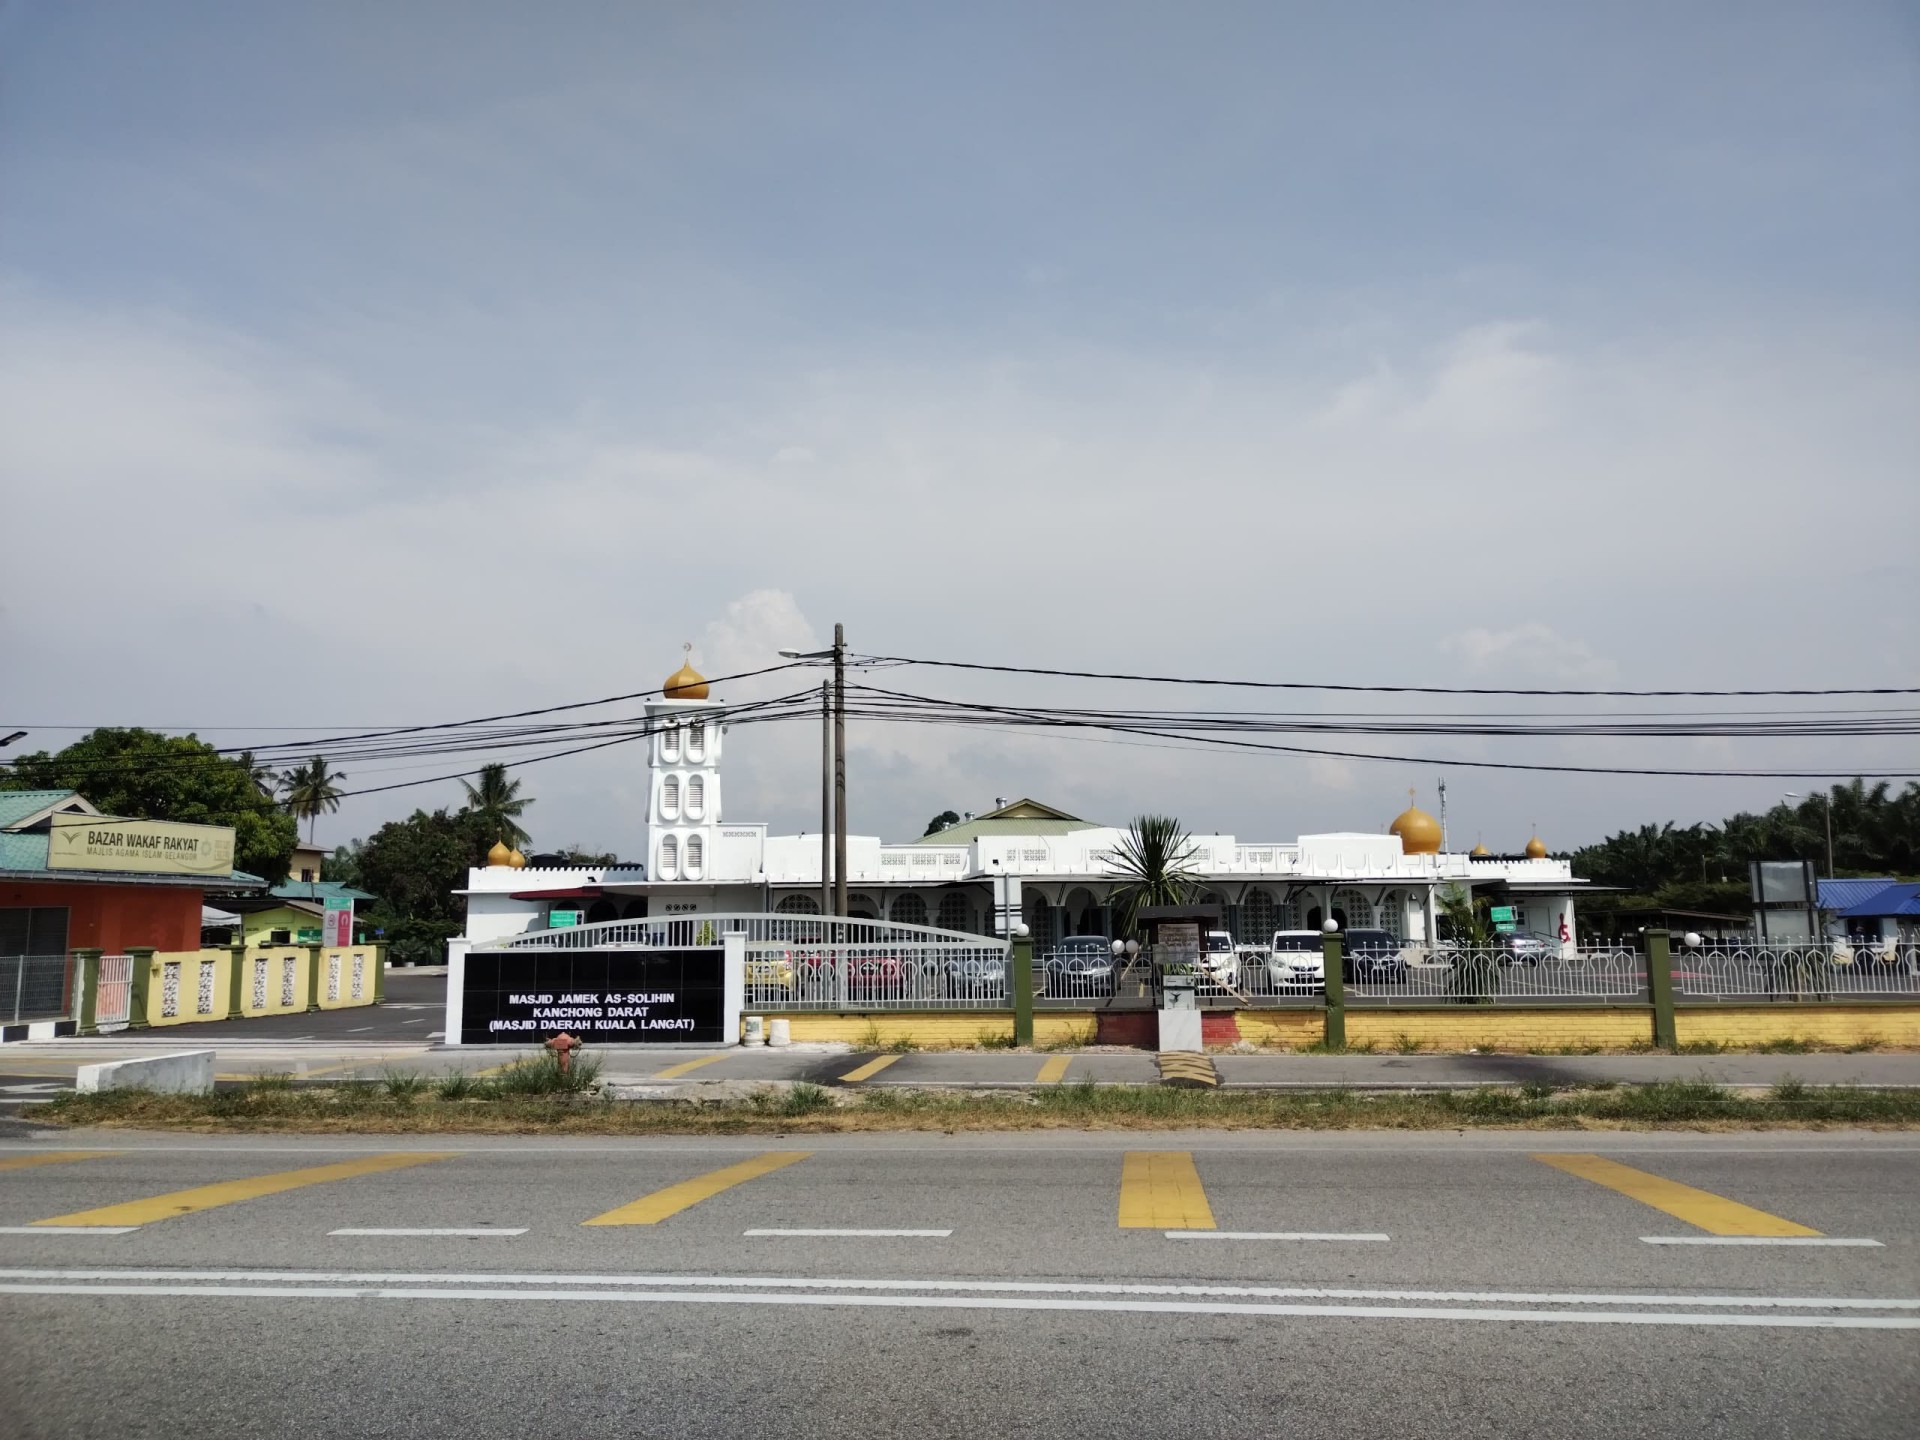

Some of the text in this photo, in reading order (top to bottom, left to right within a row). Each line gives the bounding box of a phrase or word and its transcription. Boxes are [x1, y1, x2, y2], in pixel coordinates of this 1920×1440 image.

[88, 831, 123, 846] BAZAR
[126, 834, 162, 849] WAKAF
[163, 837, 199, 851] RAKYAT
[87, 847, 113, 856] MAJLIS
[115, 848, 140, 857] AGAMA
[142, 850, 162, 859] ISLAM
[165, 851, 197, 861] SELANGOR
[509, 993, 675, 1004] MASJID JAMEK AS-SOLIHIN
[533, 1007, 649, 1018] KANCHONG DARAT
[489, 1019, 695, 1032] (MASJID DAERAH KUALA LANGAT)
